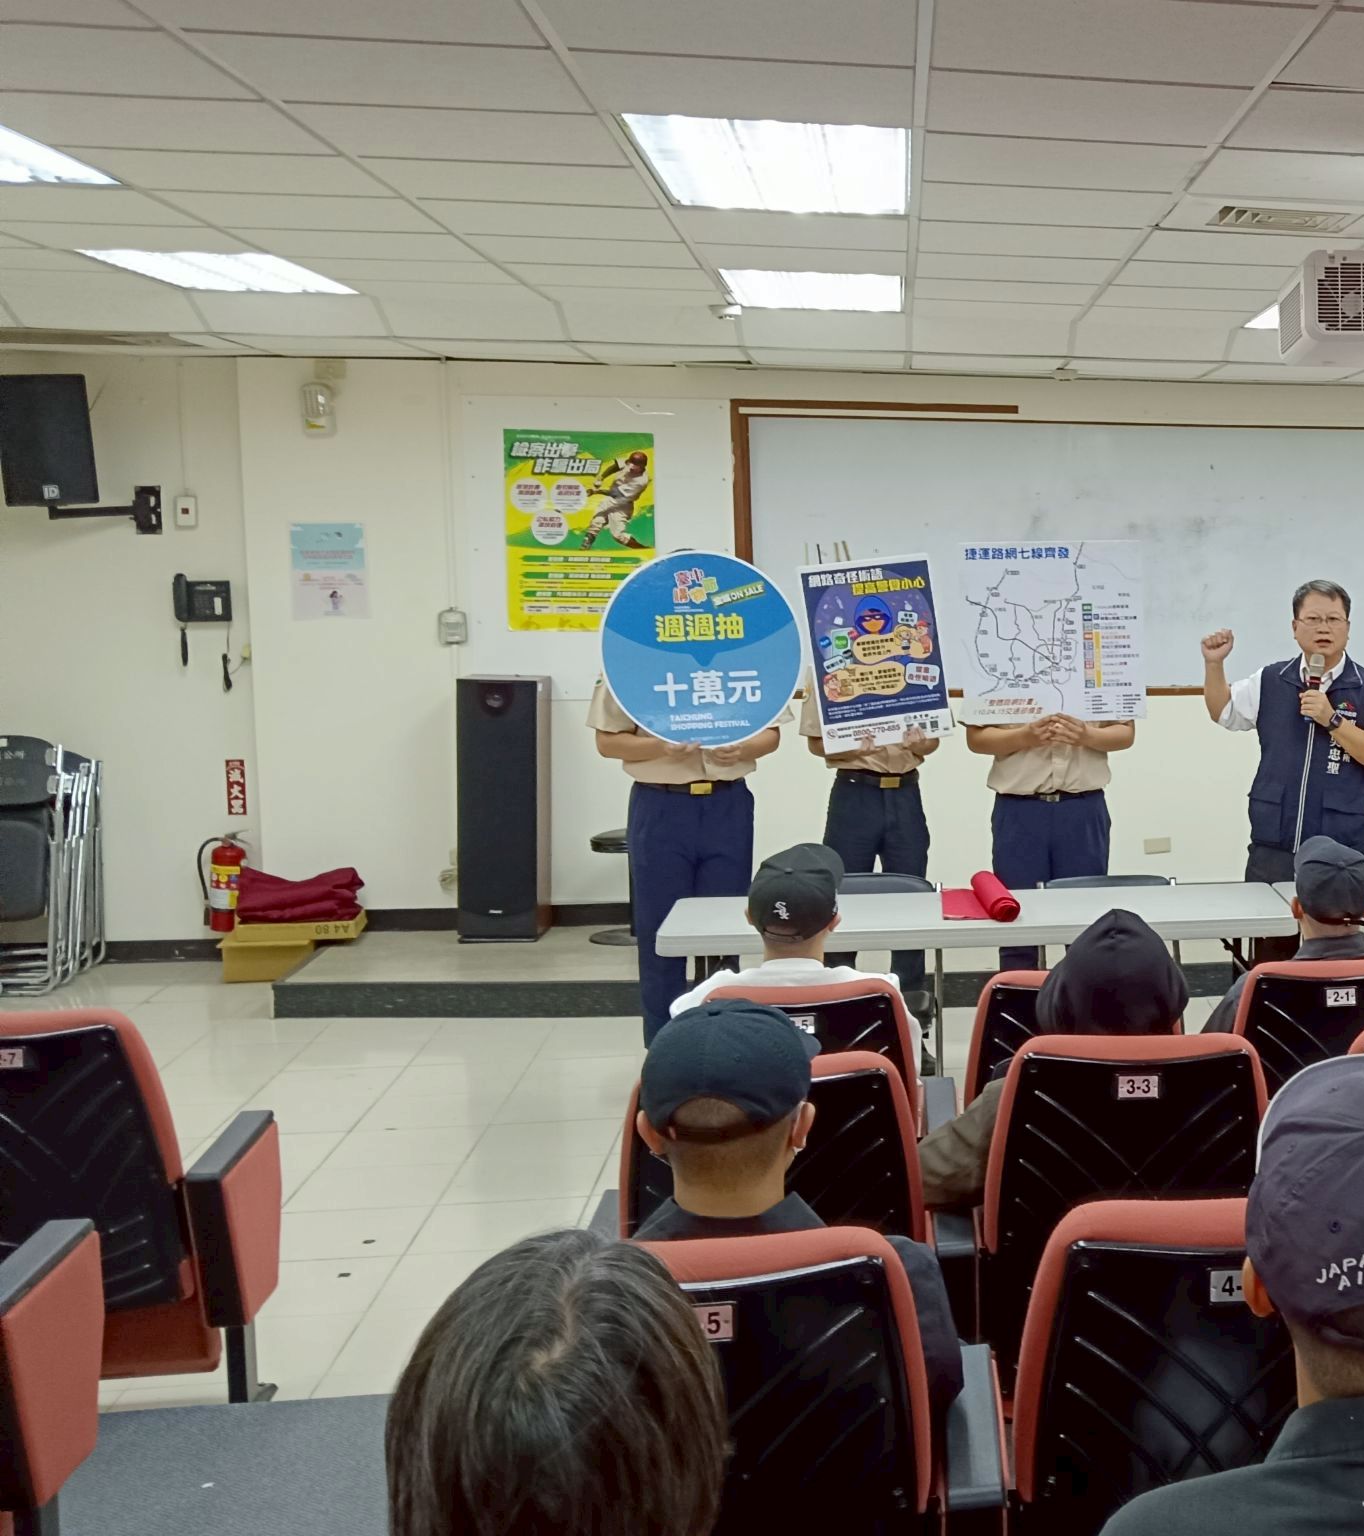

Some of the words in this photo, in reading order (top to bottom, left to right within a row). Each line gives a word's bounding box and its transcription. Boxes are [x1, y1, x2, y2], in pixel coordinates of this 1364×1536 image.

[533, 458, 602, 475] 詐騙出局
[965, 546, 1070, 560] 捷運路網七線齊發
[730, 591, 744, 601] ON
[744, 584, 764, 596] SALE
[851, 576, 926, 597] 提高警覺小心
[655, 613, 745, 642] 週週抽
[654, 669, 761, 707] 十萬元
[714, 719, 751, 728] FESTIVAL
[1333, 991, 1350, 1003] 2-1
[1126, 1078, 1151, 1095] 3-3
